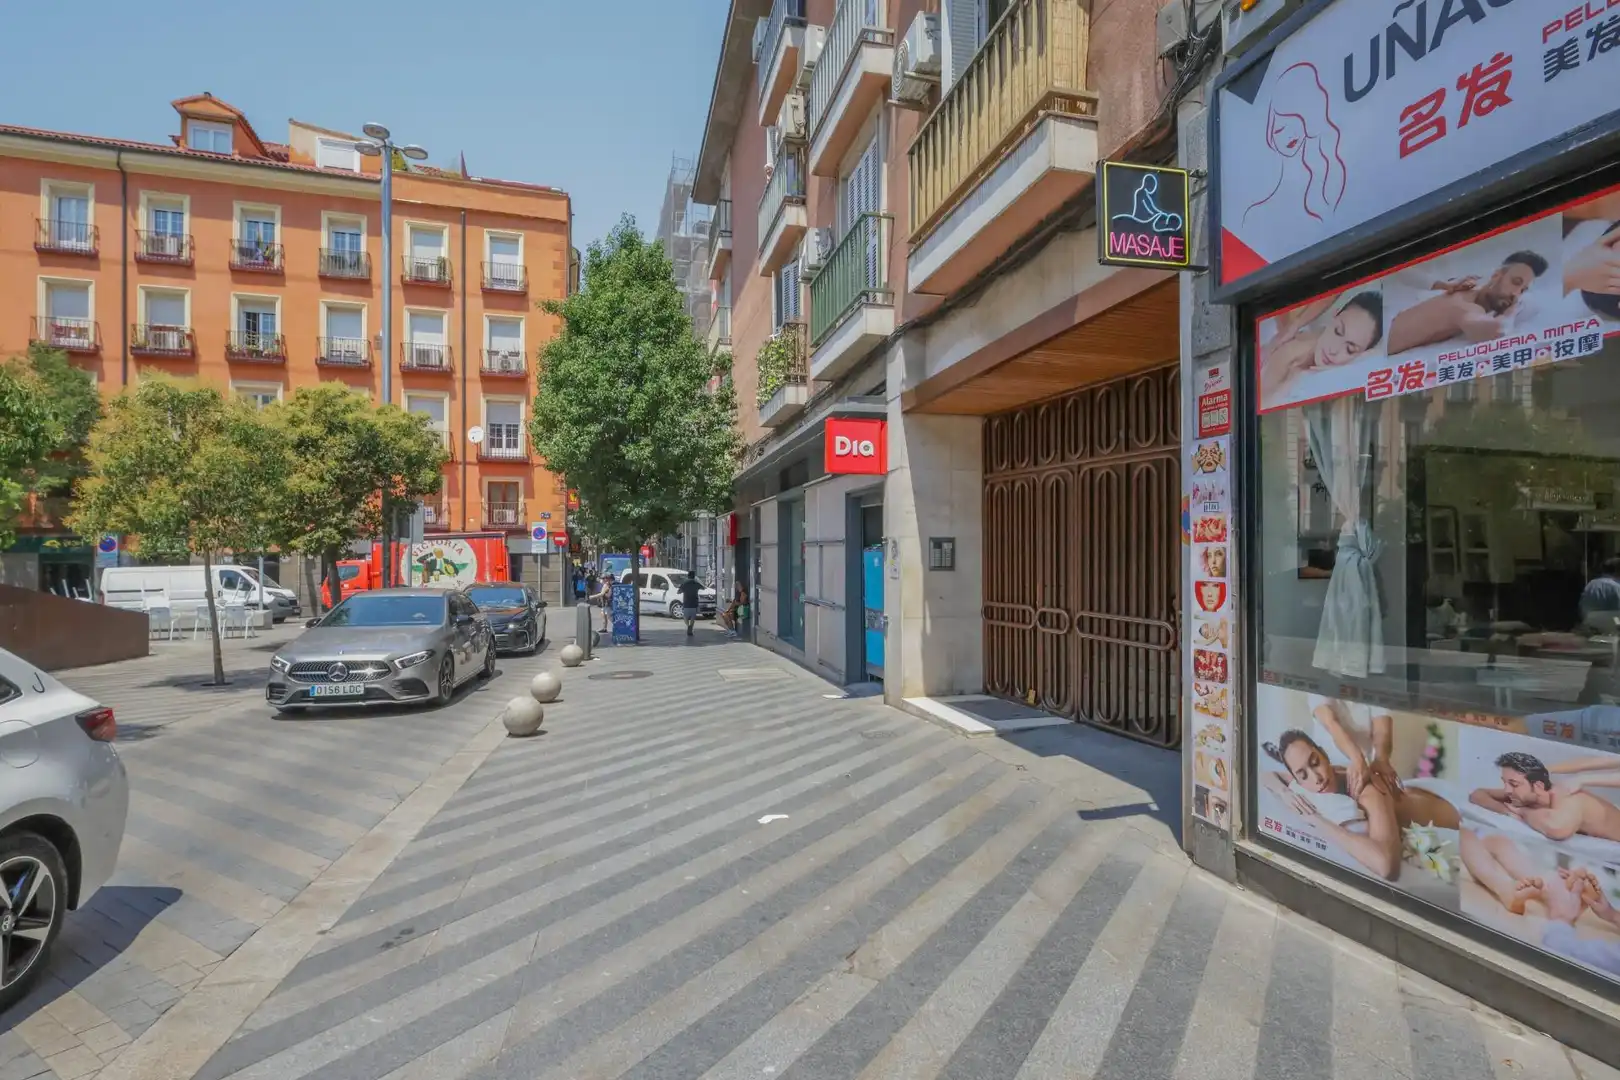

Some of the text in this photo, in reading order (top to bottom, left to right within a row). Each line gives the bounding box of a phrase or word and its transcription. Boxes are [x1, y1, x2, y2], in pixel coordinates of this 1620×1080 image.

[1542, 0, 1620, 44] PEL
[1344, 0, 1513, 103] UÑA
[1399, 52, 1513, 160] 名发
[1109, 231, 1184, 258] MASAJE
[1438, 318, 1600, 364] PELUQUERIA MINFA
[1201, 394, 1228, 407] Alarma
[412, 539, 464, 557] VICTORIA
[316, 684, 361, 695] 0156 LDC
